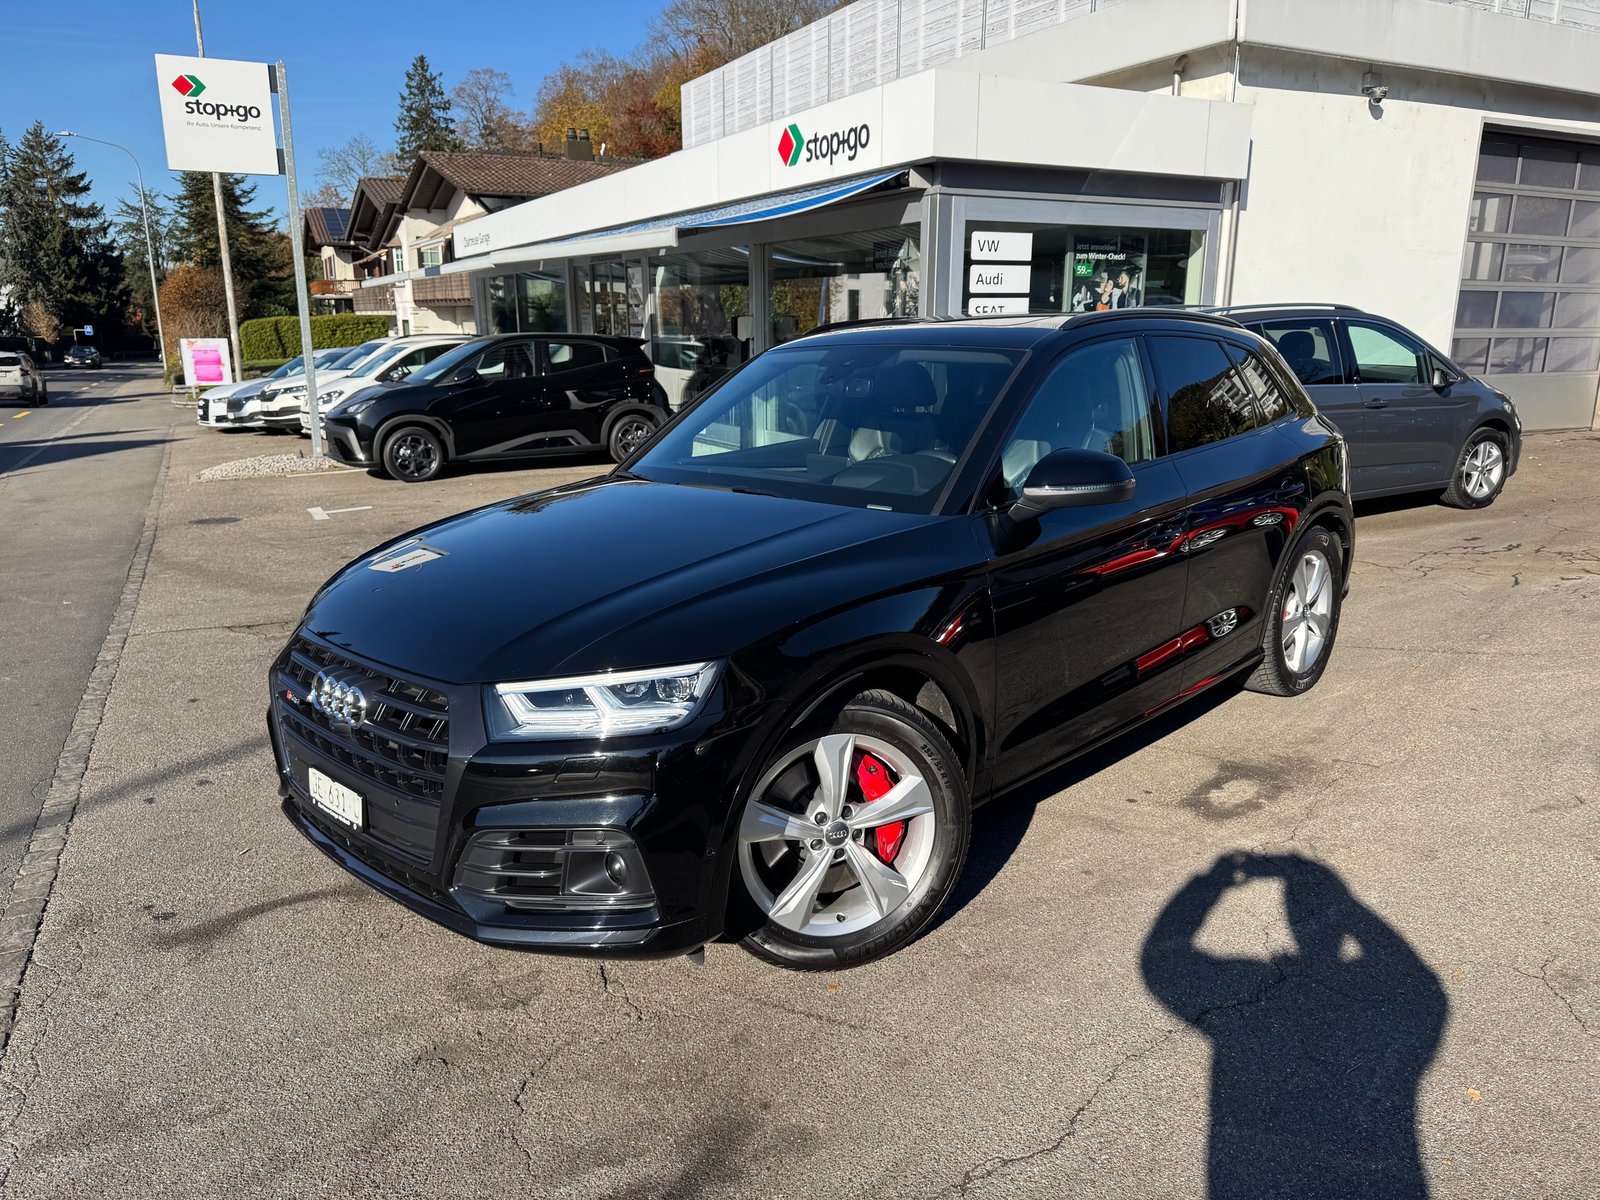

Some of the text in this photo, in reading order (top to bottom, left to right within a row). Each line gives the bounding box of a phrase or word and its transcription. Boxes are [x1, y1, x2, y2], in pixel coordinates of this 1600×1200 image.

[185, 99, 261, 122] stop+go
[230, 123, 263, 131] Kompetenz.
[805, 123, 870, 165] stop+go
[978, 239, 1000, 252] VW
[1090, 243, 1117, 251] anmelden
[1088, 252, 1126, 260] Winter-Check!
[975, 272, 1004, 286] Audi
